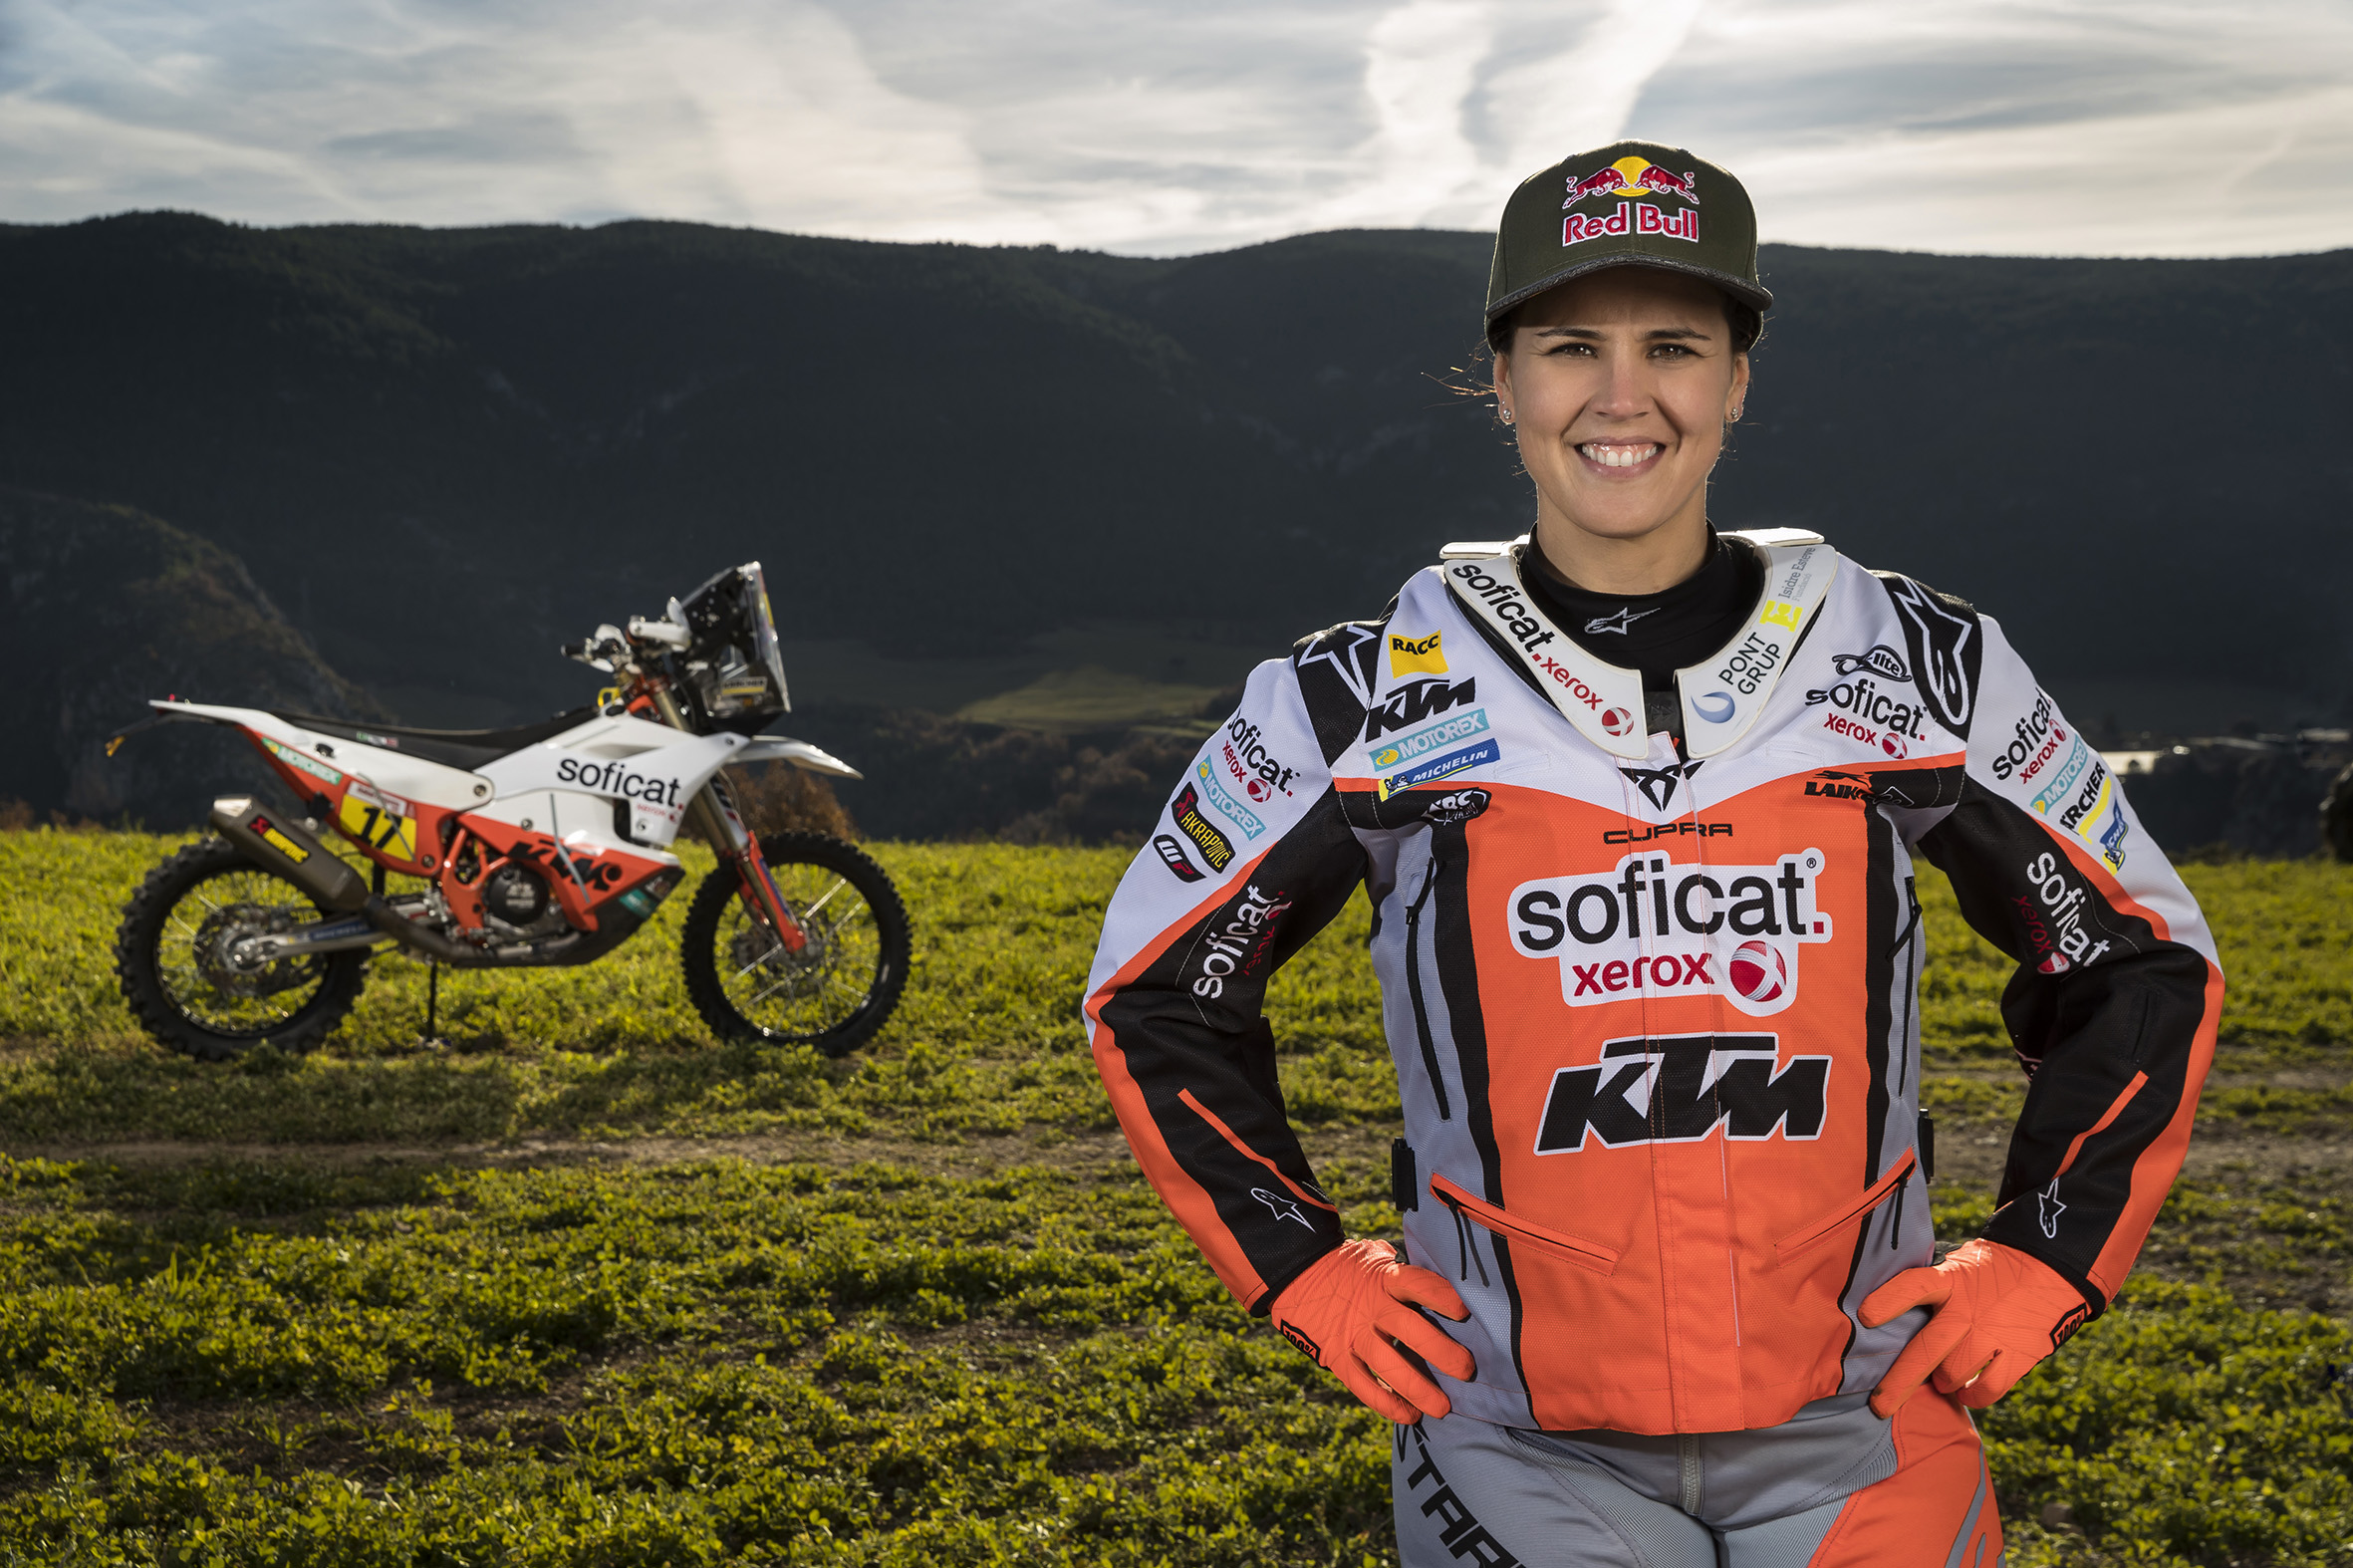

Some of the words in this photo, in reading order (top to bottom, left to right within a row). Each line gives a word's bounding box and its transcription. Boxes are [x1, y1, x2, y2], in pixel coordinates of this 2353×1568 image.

[1563, 202, 1629, 246] Red
[1637, 203, 1699, 242] Bull
[1778, 572, 1801, 599] Isidre
[1393, 635, 1439, 655] RACC
[1718, 633, 1766, 685] PONT
[1737, 643, 1781, 694] GRUP
[1540, 656, 1603, 710] xerox
[1365, 676, 1475, 743] KTM
[1824, 712, 1877, 746] xerox
[1399, 711, 1485, 759] MOTOREX
[1222, 739, 1247, 783] xerox
[1413, 749, 1488, 782] MICHELIN
[2019, 737, 2058, 785] xerox
[2042, 741, 2087, 804] MOTORE
[355, 806, 402, 850] 17
[1203, 774, 1265, 839] MOTOREX
[1603, 822, 1733, 845] CUPRA
[2012, 896, 2053, 953] xerox
[1572, 952, 1714, 996] xerox
[1536, 1035, 1829, 1152] KTM
